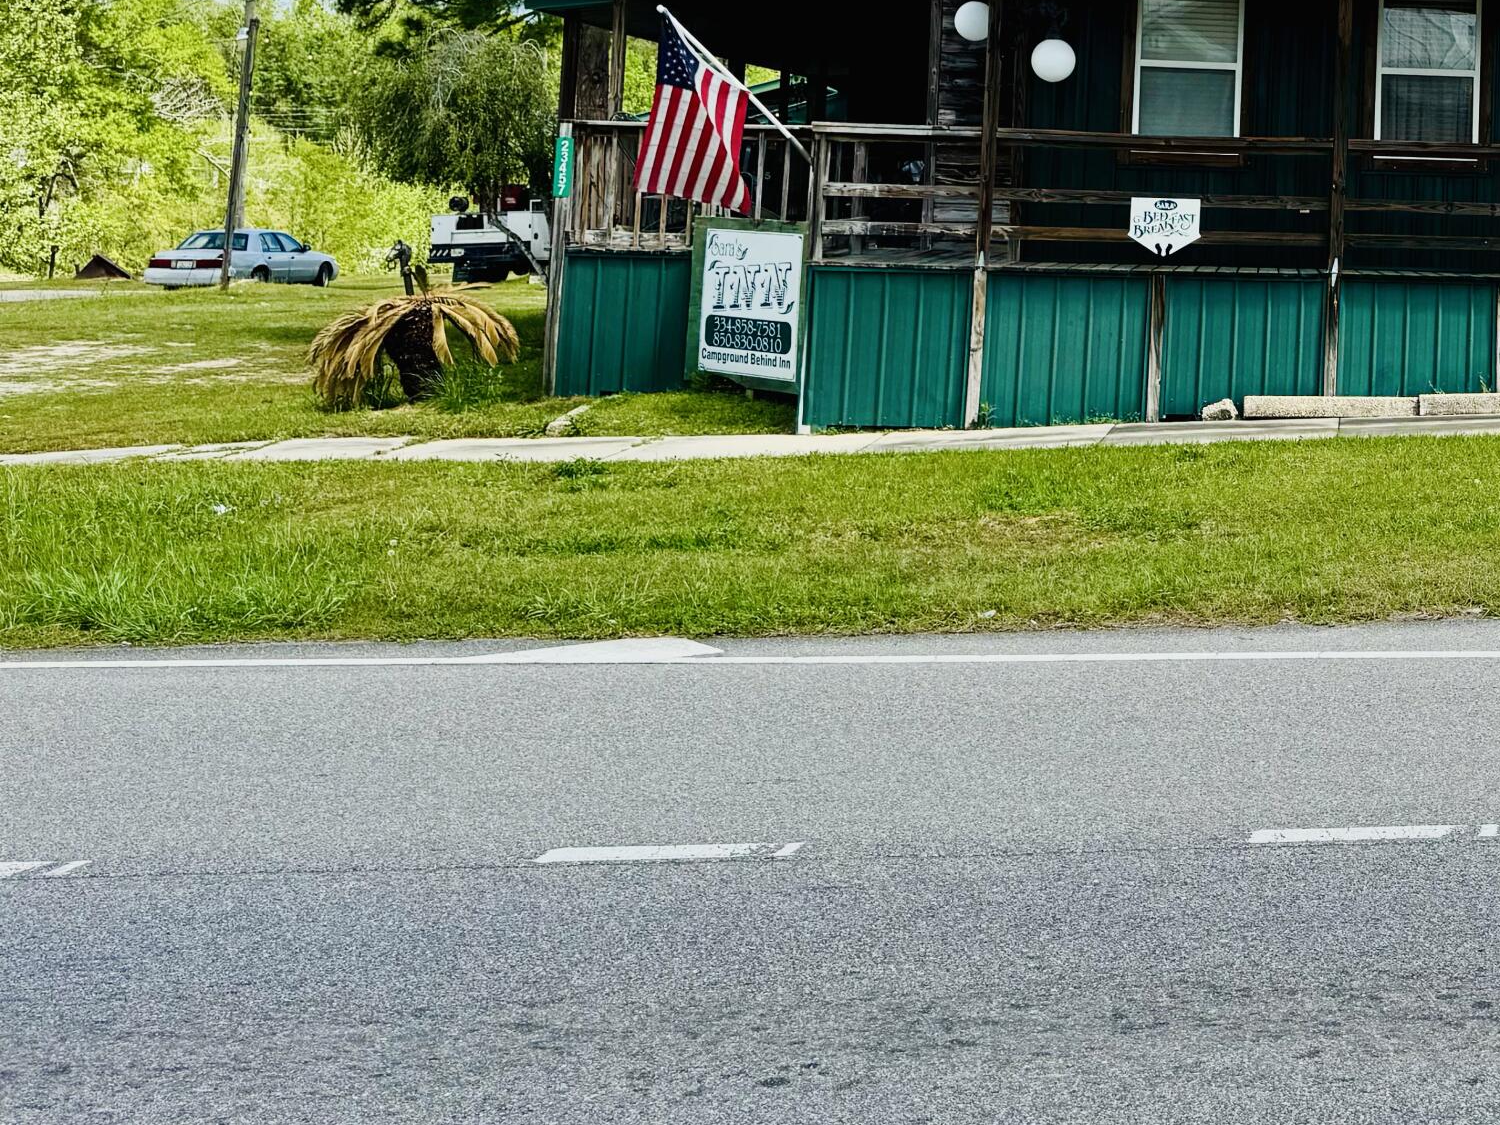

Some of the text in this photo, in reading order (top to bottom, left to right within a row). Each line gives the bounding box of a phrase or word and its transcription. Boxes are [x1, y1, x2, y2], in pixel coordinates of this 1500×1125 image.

[557, 140, 569, 196] 23457
[1143, 211, 1169, 225] BED
[710, 234, 743, 259] Sara's
[712, 262, 792, 312] INN
[713, 316, 782, 338] 334-858-7581
[712, 332, 782, 353] 850-830-0810
[701, 348, 791, 369] Campground Behind Inn
